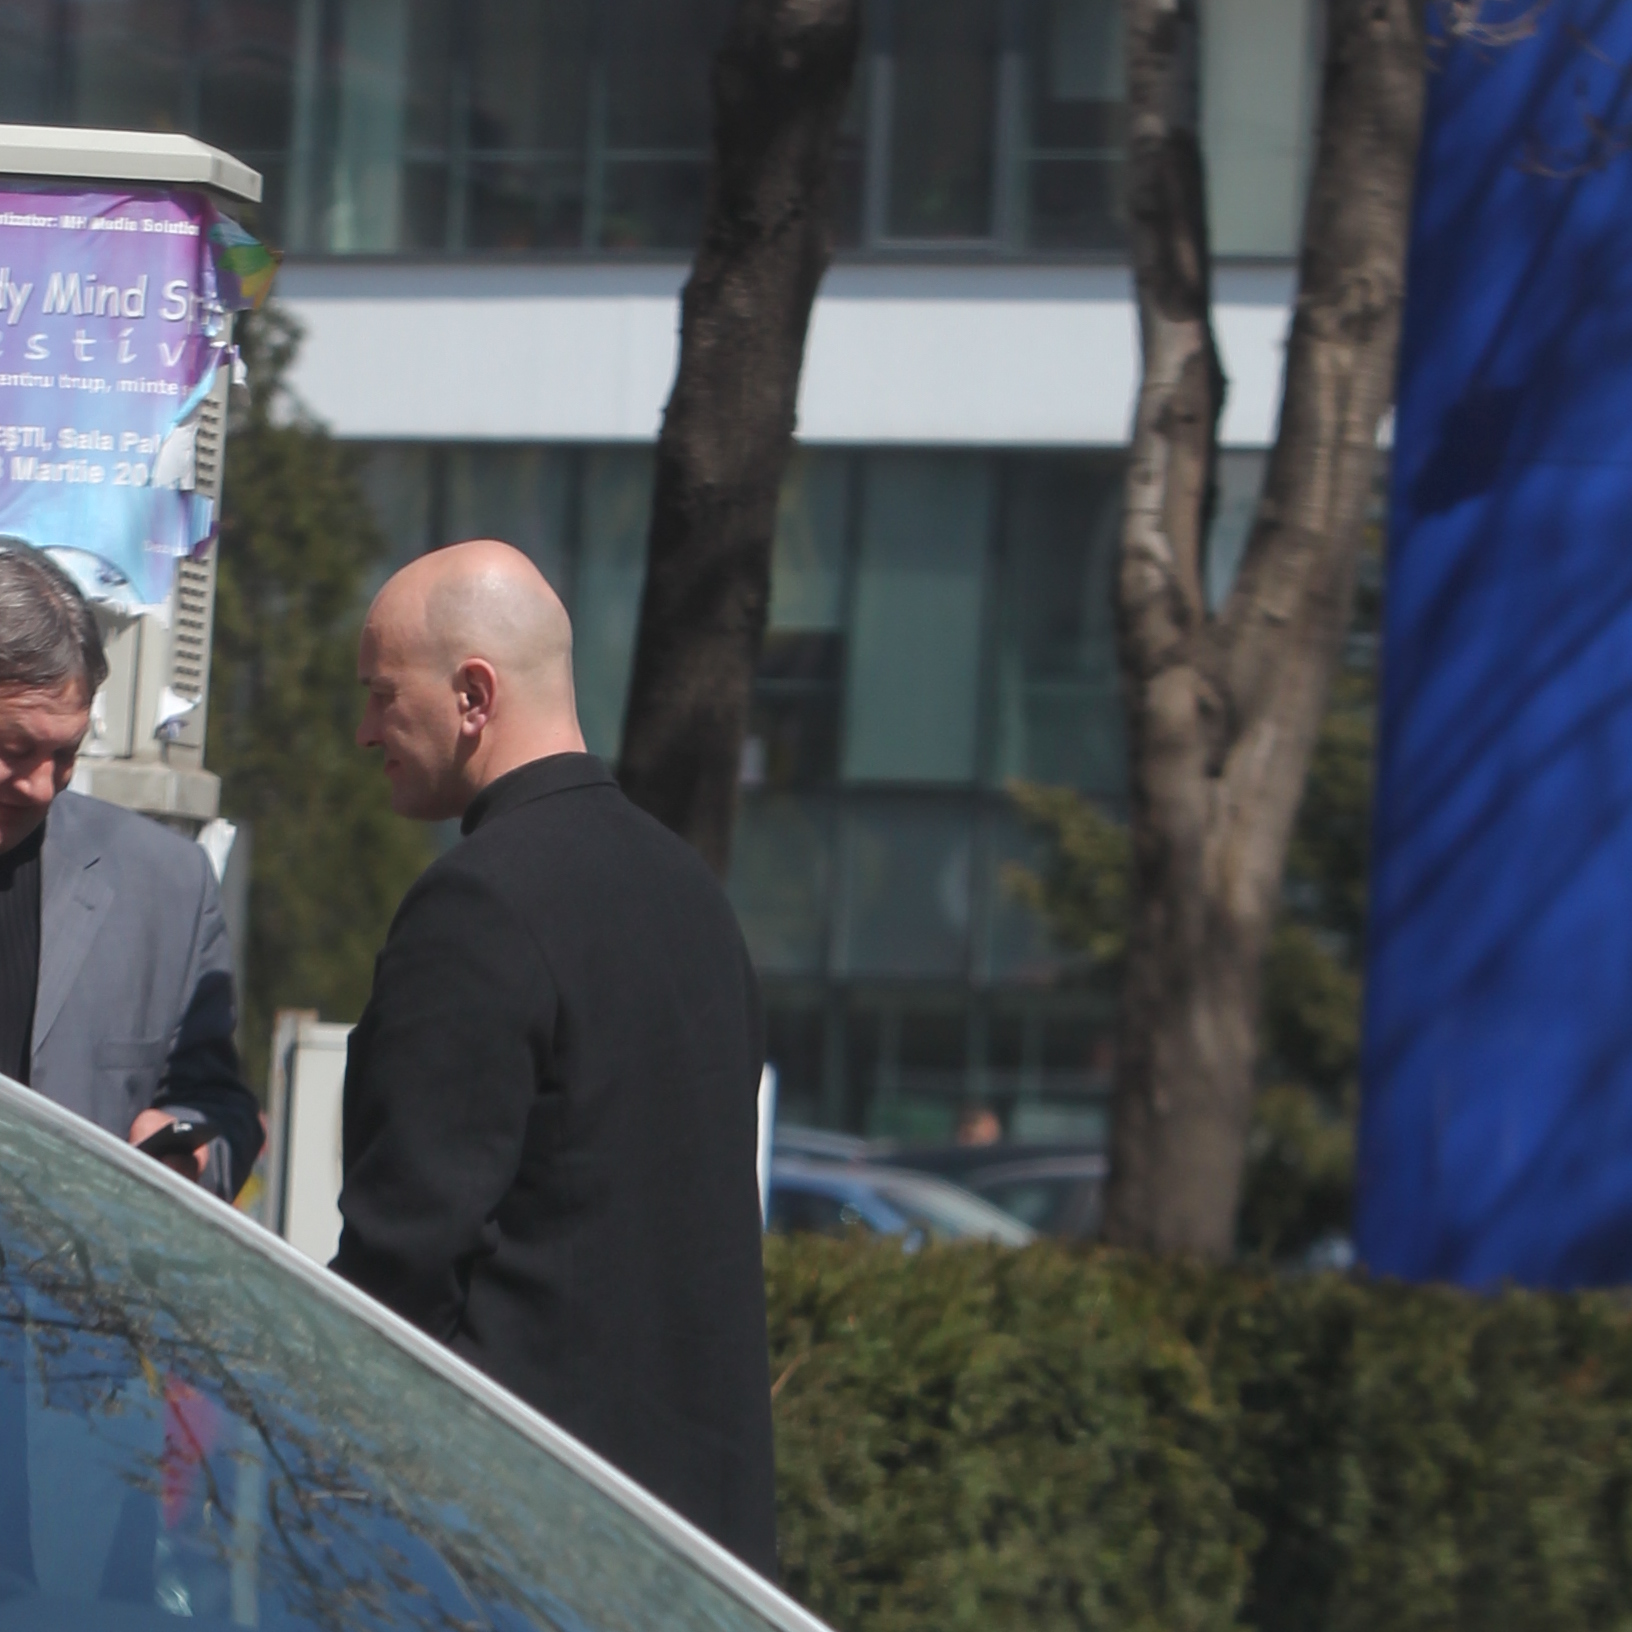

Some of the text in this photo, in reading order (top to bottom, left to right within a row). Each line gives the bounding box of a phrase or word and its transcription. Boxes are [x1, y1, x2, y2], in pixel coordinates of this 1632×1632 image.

[42, 272, 148, 319] Mind
[116, 377, 179, 395] minte
[57, 429, 114, 451] Sala
[10, 458, 105, 483] Martie
